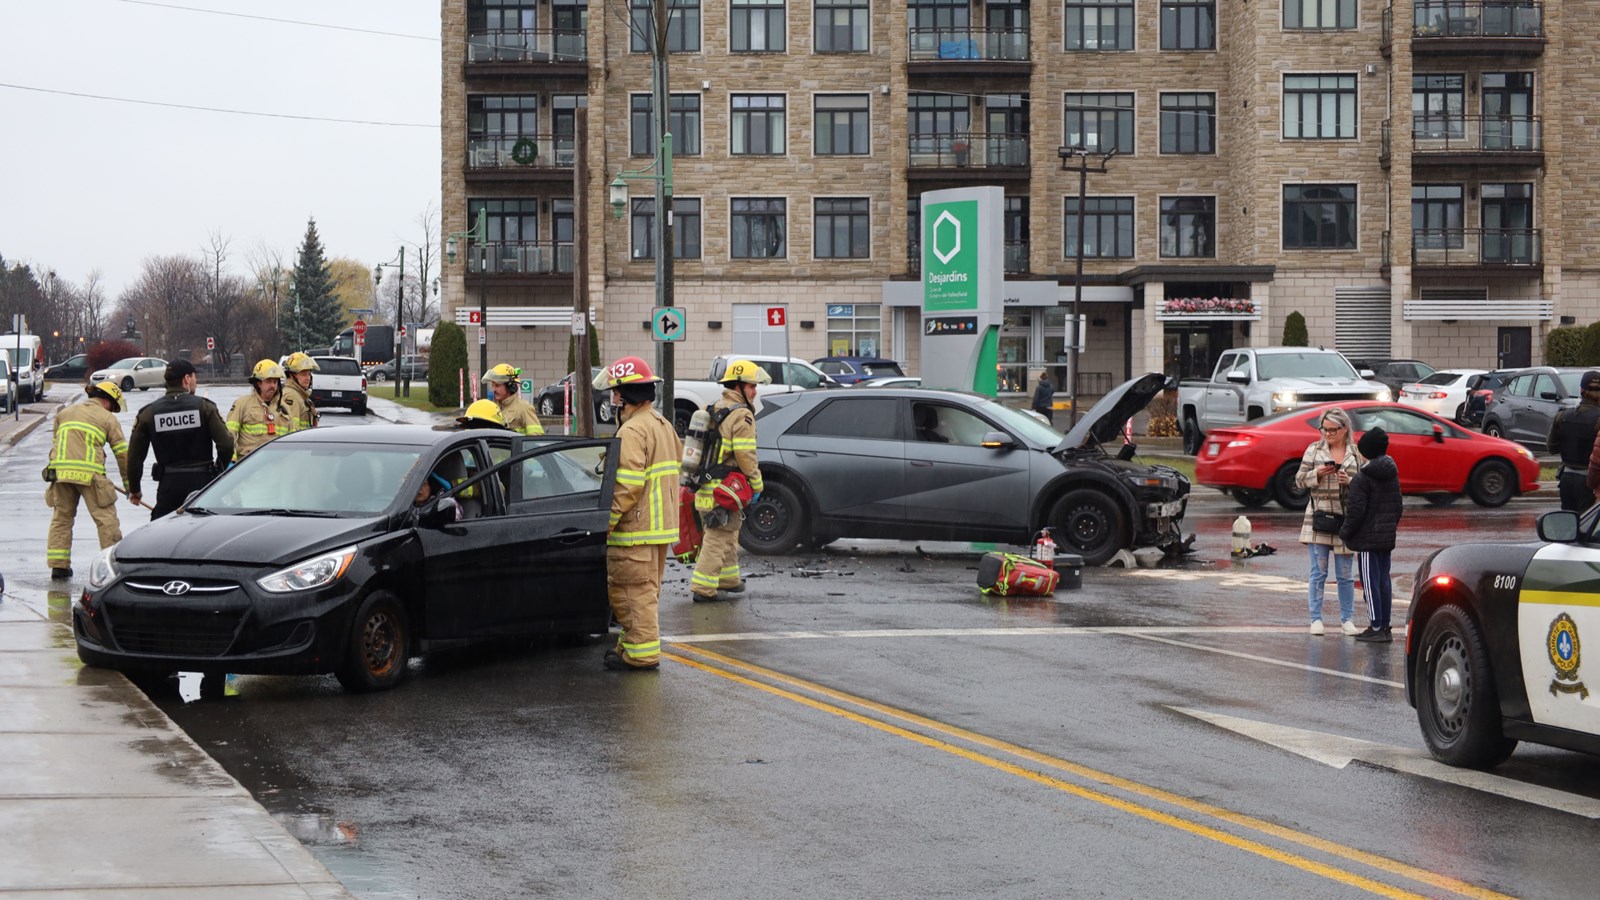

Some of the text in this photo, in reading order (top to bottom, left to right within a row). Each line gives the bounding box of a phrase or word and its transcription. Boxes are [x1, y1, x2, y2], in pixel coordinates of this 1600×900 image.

[929, 270, 968, 285] Desjardins
[610, 362, 635, 378] 132
[731, 365, 744, 376] 19
[160, 414, 196, 428] POLICE
[1494, 574, 1516, 590] 8100
